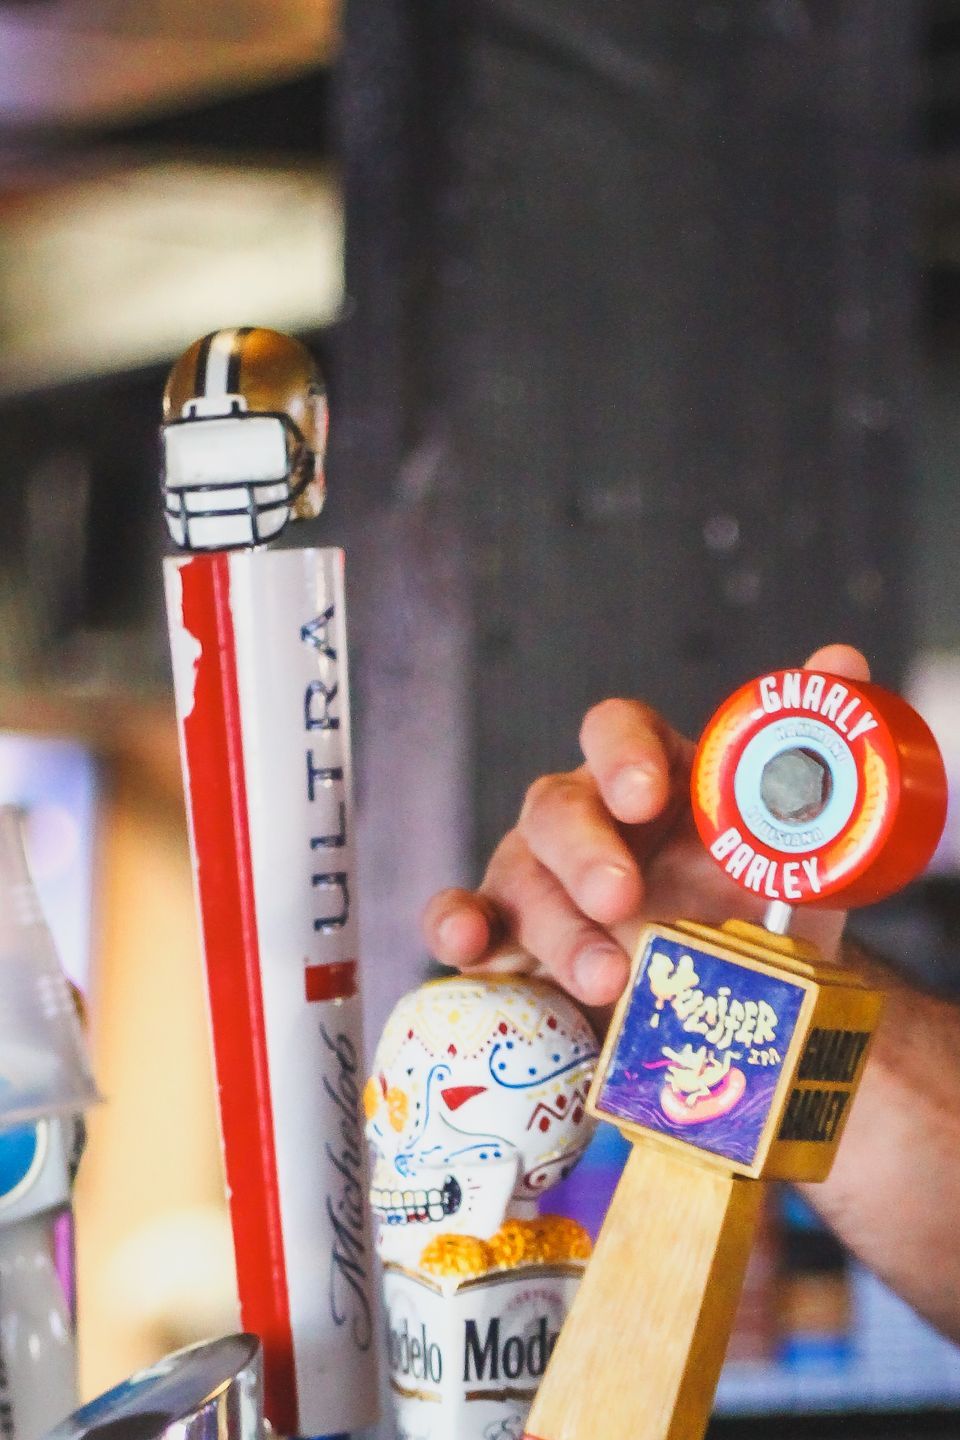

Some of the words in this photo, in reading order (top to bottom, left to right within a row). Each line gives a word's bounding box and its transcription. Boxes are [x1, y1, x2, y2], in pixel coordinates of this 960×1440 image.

[759, 672, 879, 742] GNARLY
[300, 604, 350, 932] ULTRA
[709, 827, 822, 900] BARLEY
[317, 1021, 373, 1352] Michelob
[463, 1316, 560, 1383] Mod
